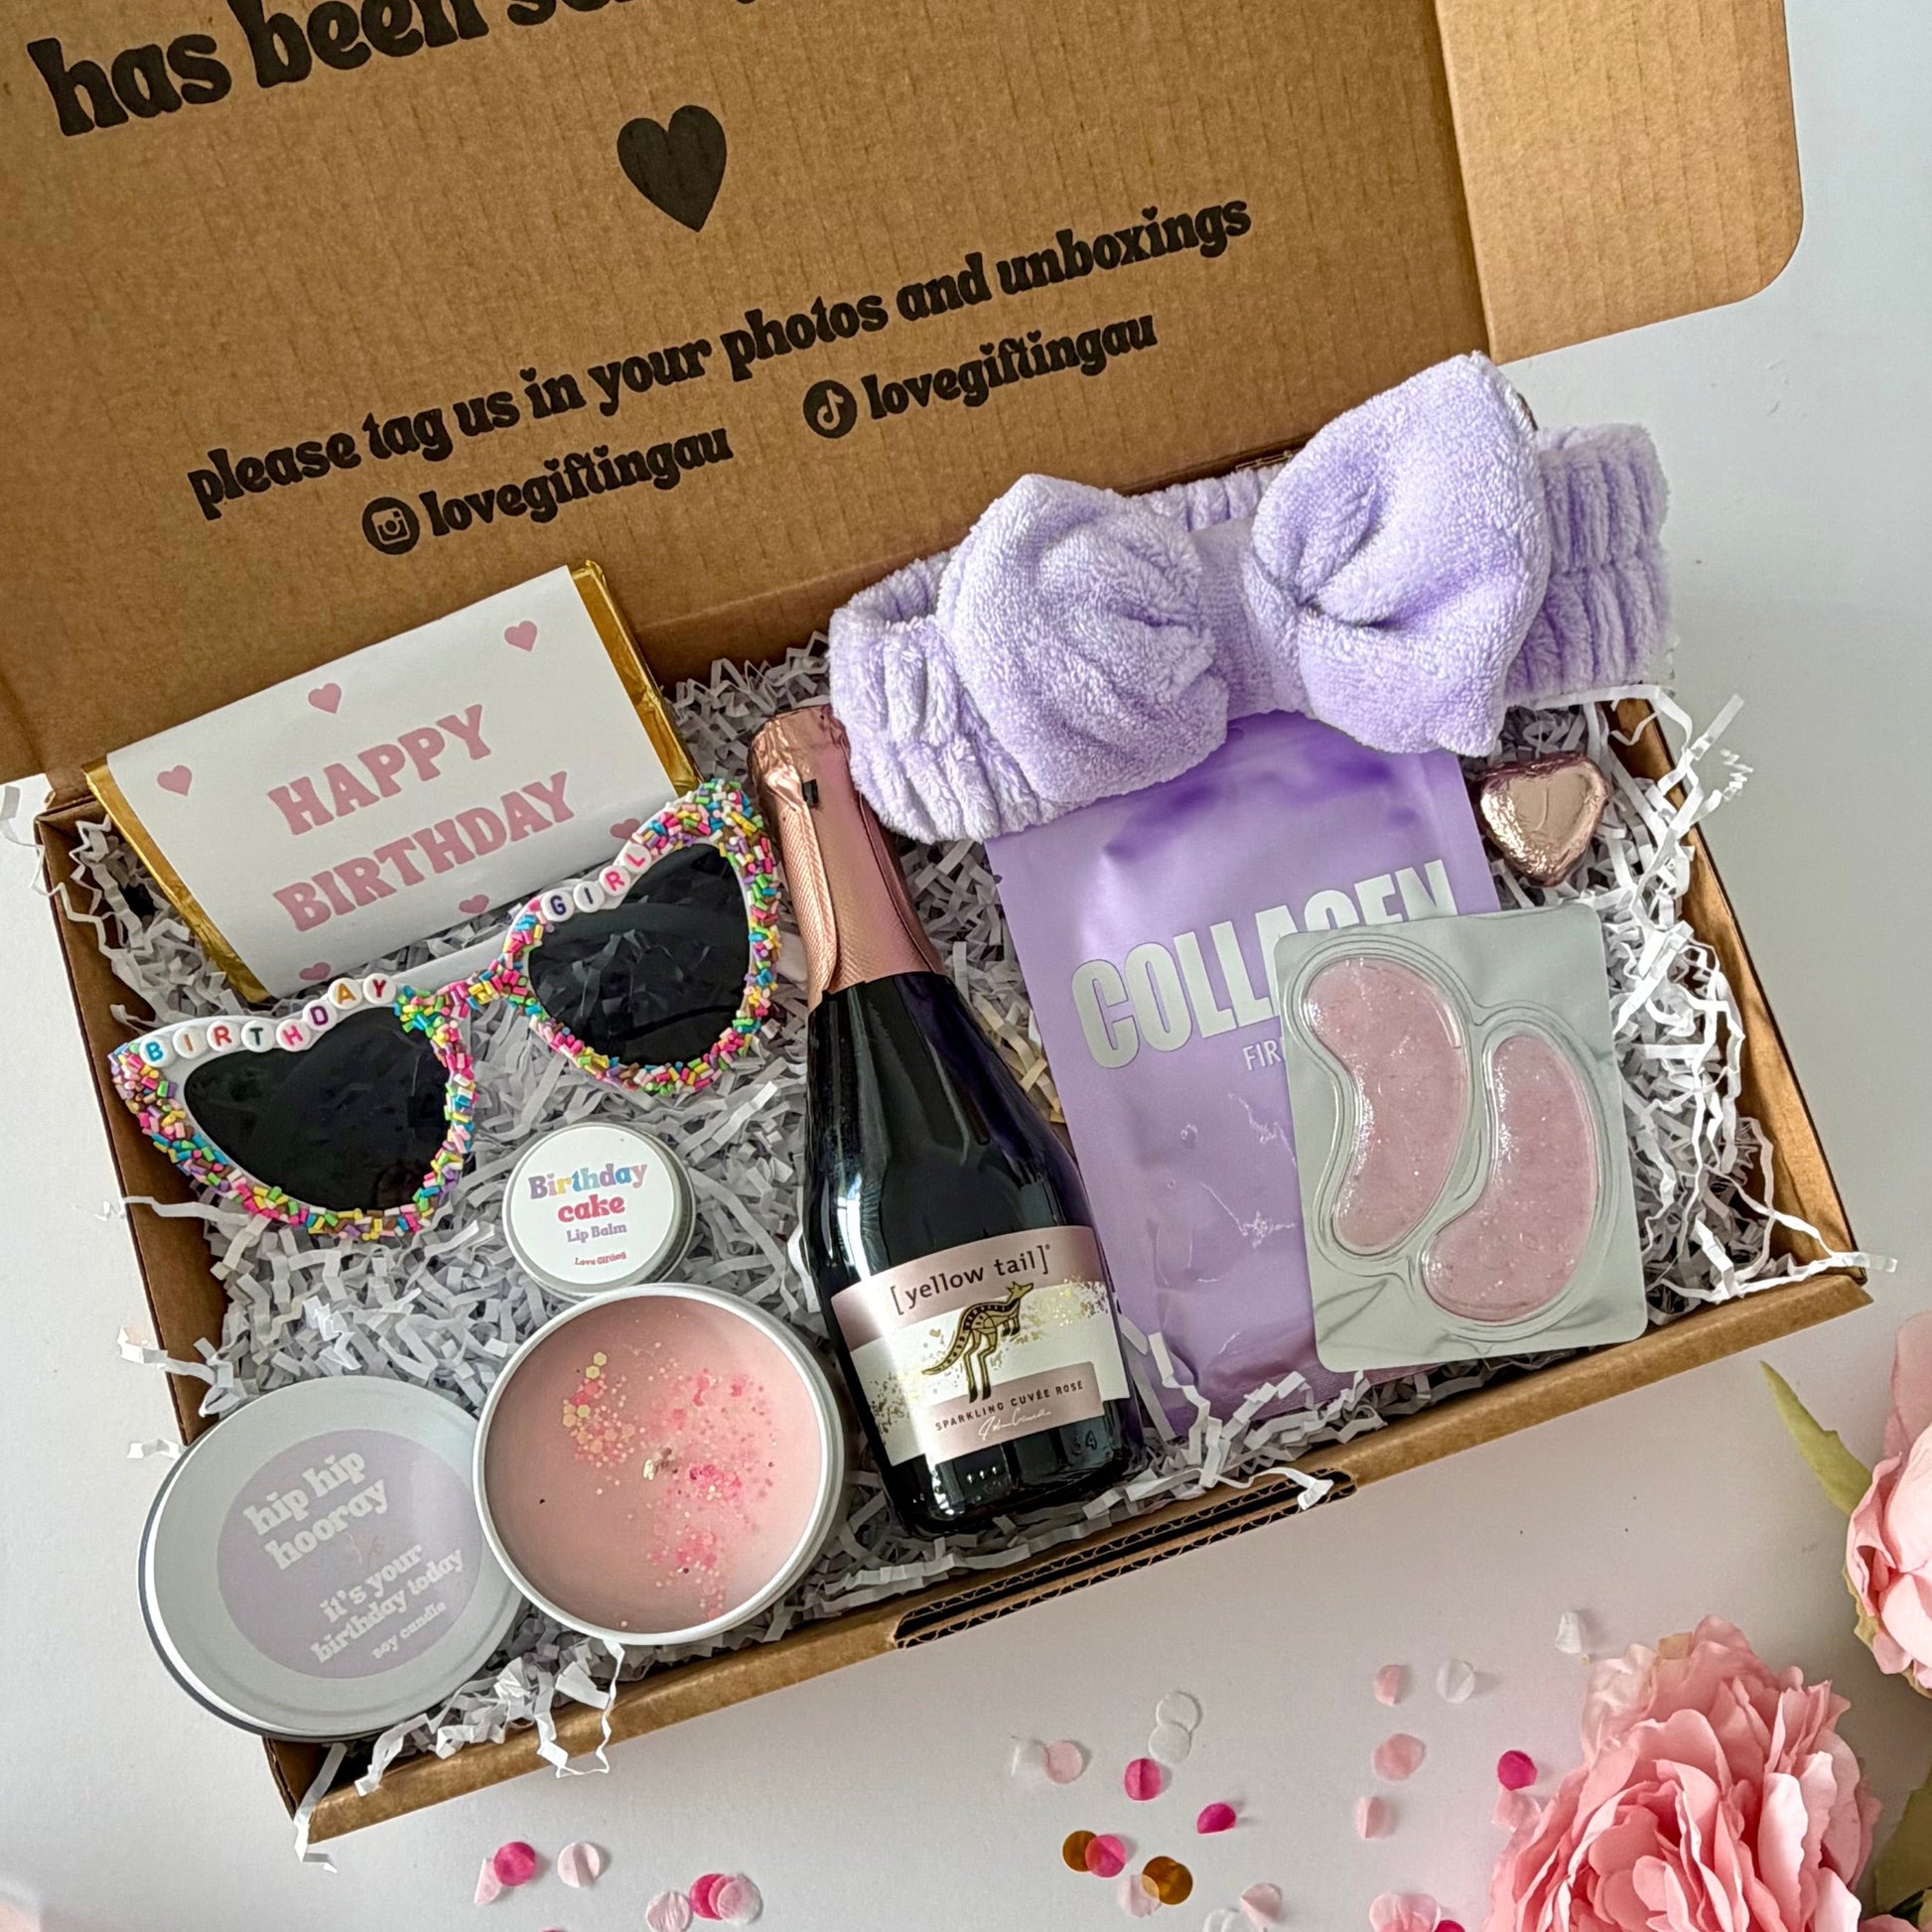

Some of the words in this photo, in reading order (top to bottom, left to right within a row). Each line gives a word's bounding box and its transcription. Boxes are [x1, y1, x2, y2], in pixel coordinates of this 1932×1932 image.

[27, 34, 232, 136] has
[226, 0, 488, 88] been
[188, 432, 361, 520] please
[362, 408, 453, 461] tag
[453, 390, 520, 437] us
[520, 366, 587, 419] in
[587, 339, 712, 417] your
[720, 295, 889, 382] photos
[897, 252, 992, 321] and
[997, 200, 1251, 295] unboxings
[861, 315, 1158, 419] lovegiftingau
[419, 428, 734, 536] lovegiftingau
[266, 704, 491, 835] HAPPY
[272, 770, 575, 932] BIRTHDAY
[549, 852, 646, 915] GIRL
[145, 978, 387, 1062] BIRTHDAY
[528, 1163, 648, 1199] Birthday
[558, 1193, 625, 1222] cake
[566, 1230, 589, 1243] Lip
[591, 1223, 627, 1239] Balm
[935, 1402, 1005, 1432] SPARKLING
[243, 1489, 309, 1536] hip
[303, 1452, 365, 1497] hip
[264, 1479, 388, 1571] hooray
[310, 1589, 408, 1663] birthday
[407, 1549, 464, 1595] today
[365, 1544, 422, 1597] your
[372, 1636, 399, 1660] soy
[400, 1601, 447, 1639] candle
